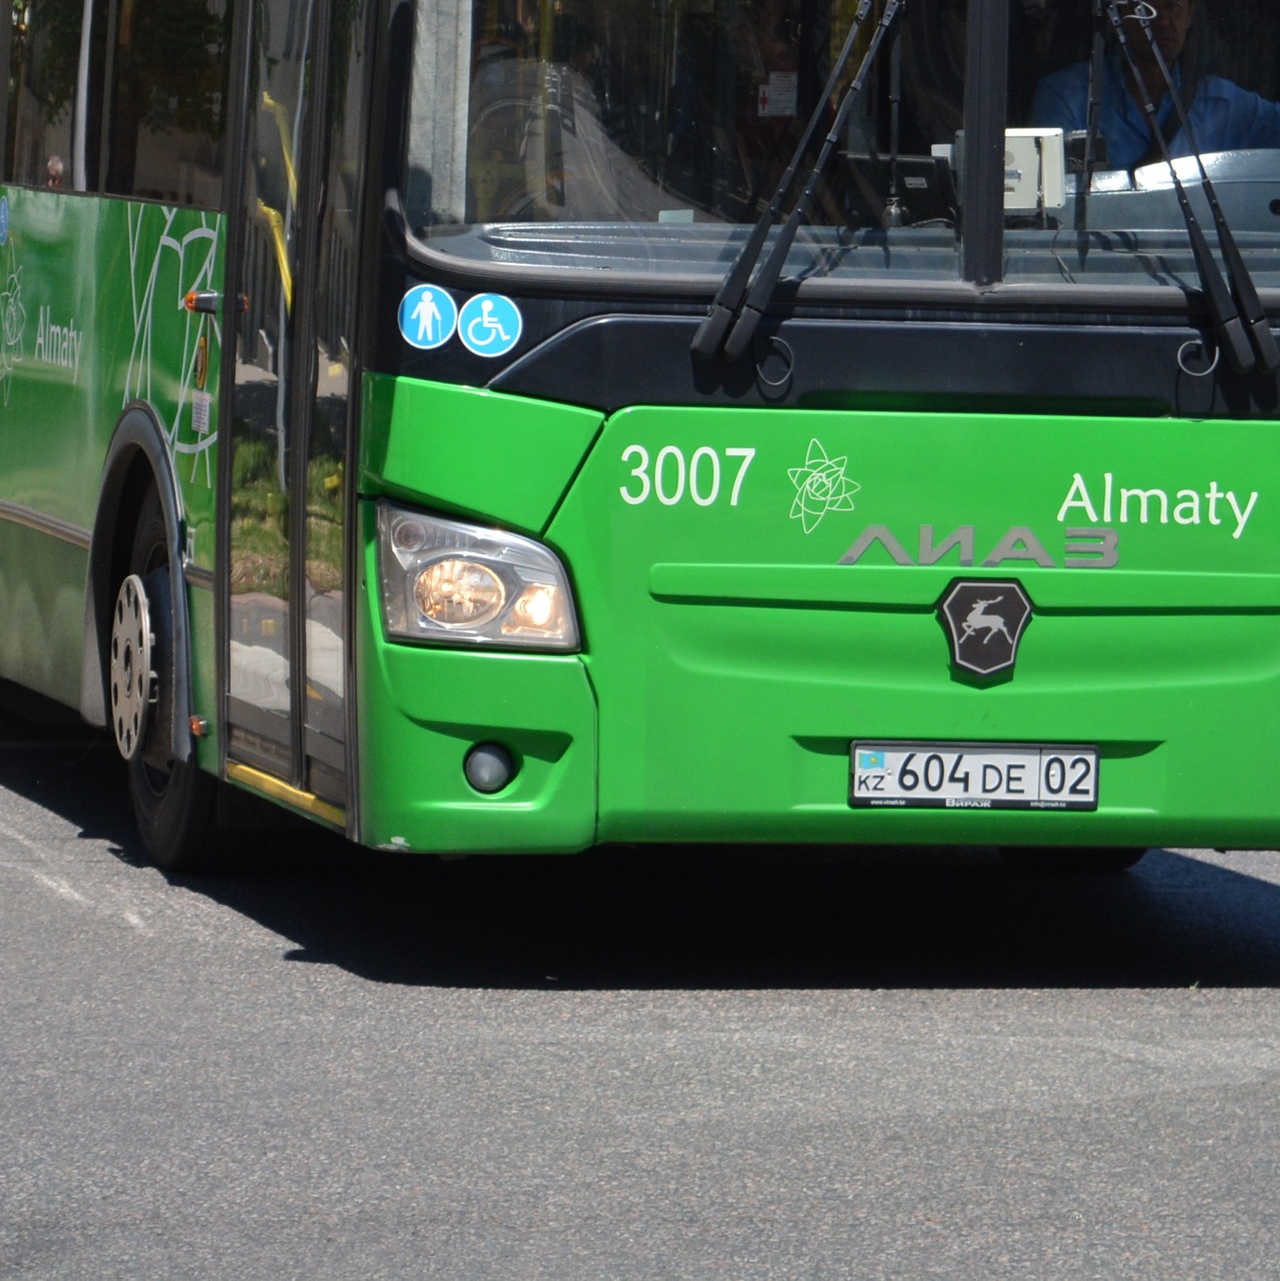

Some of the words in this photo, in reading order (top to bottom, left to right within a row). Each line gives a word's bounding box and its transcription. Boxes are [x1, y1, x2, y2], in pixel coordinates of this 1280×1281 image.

[34, 305, 82, 385] Almaty
[619, 444, 756, 507] 3007
[1056, 472, 1258, 540] Almaty
[836, 523, 1120, 568] ЛИАЗ
[857, 775, 885, 791] KZ
[898, 752, 970, 793] 604
[981, 764, 1026, 794] DE
[1044, 755, 1091, 796] 02
